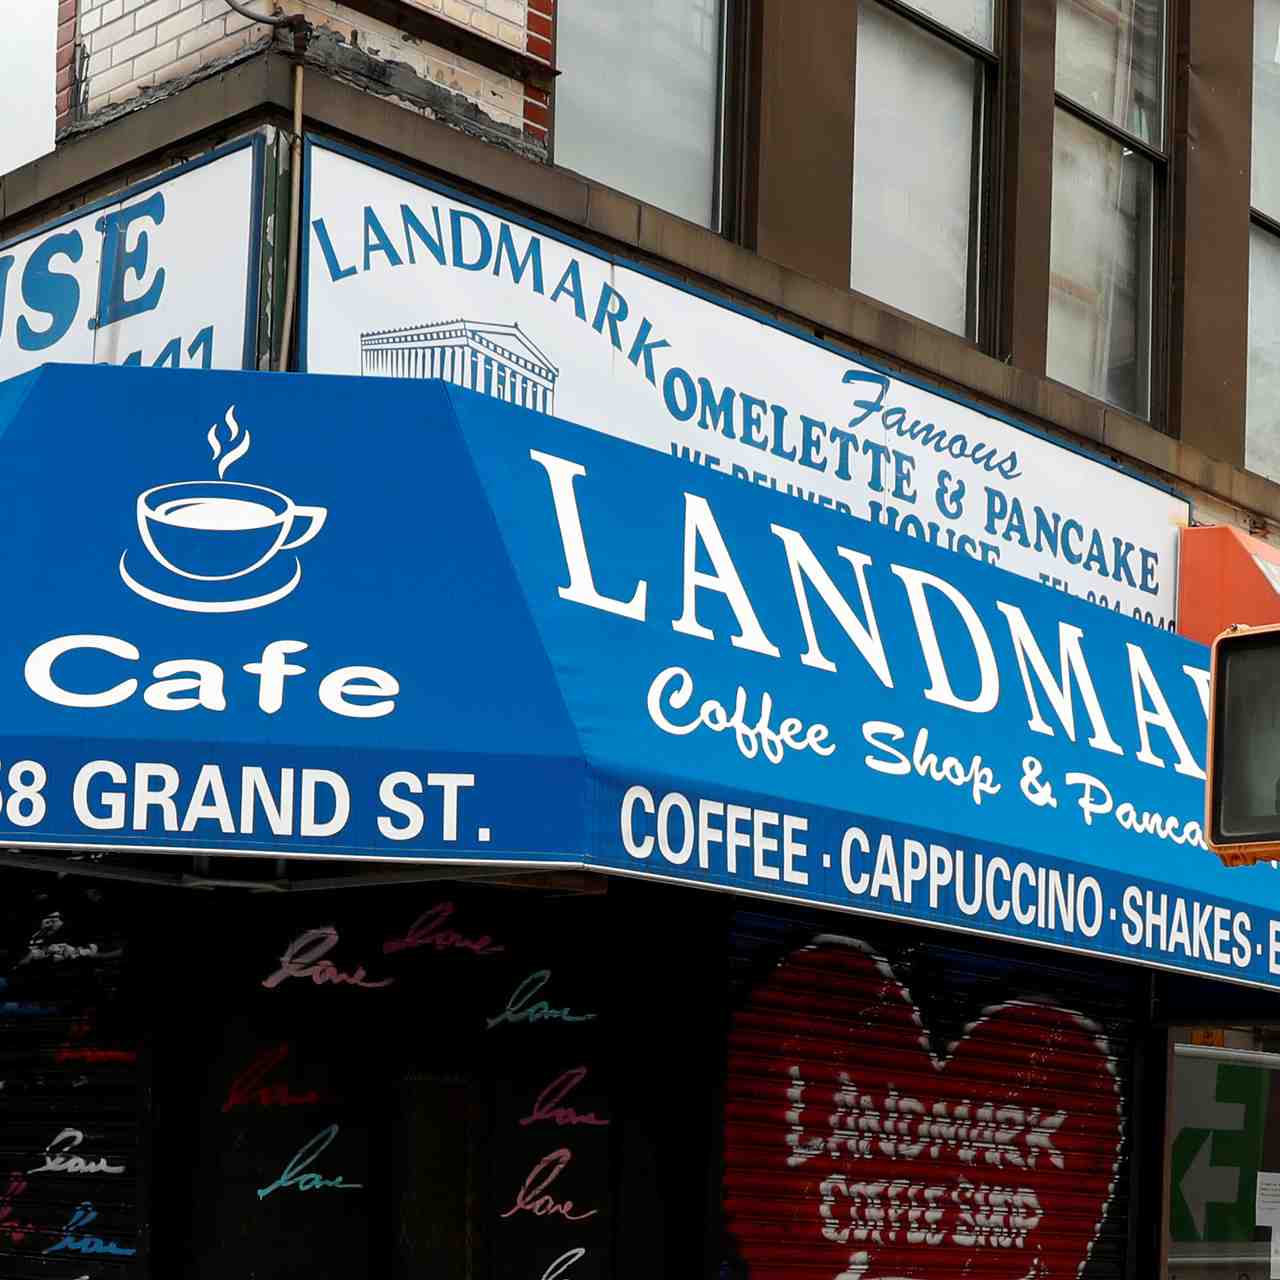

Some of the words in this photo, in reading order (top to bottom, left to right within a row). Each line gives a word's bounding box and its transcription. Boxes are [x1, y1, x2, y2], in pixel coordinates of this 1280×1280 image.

[310, 203, 670, 383] LANDMARK
[663, 366, 918, 503] OMELETTE
[936, 470, 965, 520] &
[984, 485, 1160, 595] PANCAKE
[842, 369, 1022, 480] Famous
[24, 634, 400, 718] Cafe
[529, 449, 1210, 778] LANDMA
[73, 760, 351, 837] GRAND
[376, 772, 492, 842] ST.
[646, 666, 836, 765] Coffee
[862, 719, 1001, 805] Shop
[1020, 756, 1057, 807] &
[621, 784, 810, 886] COFFEE
[841, 826, 1103, 937] CAPPUCCINO
[1122, 885, 1253, 969] SHAKES
